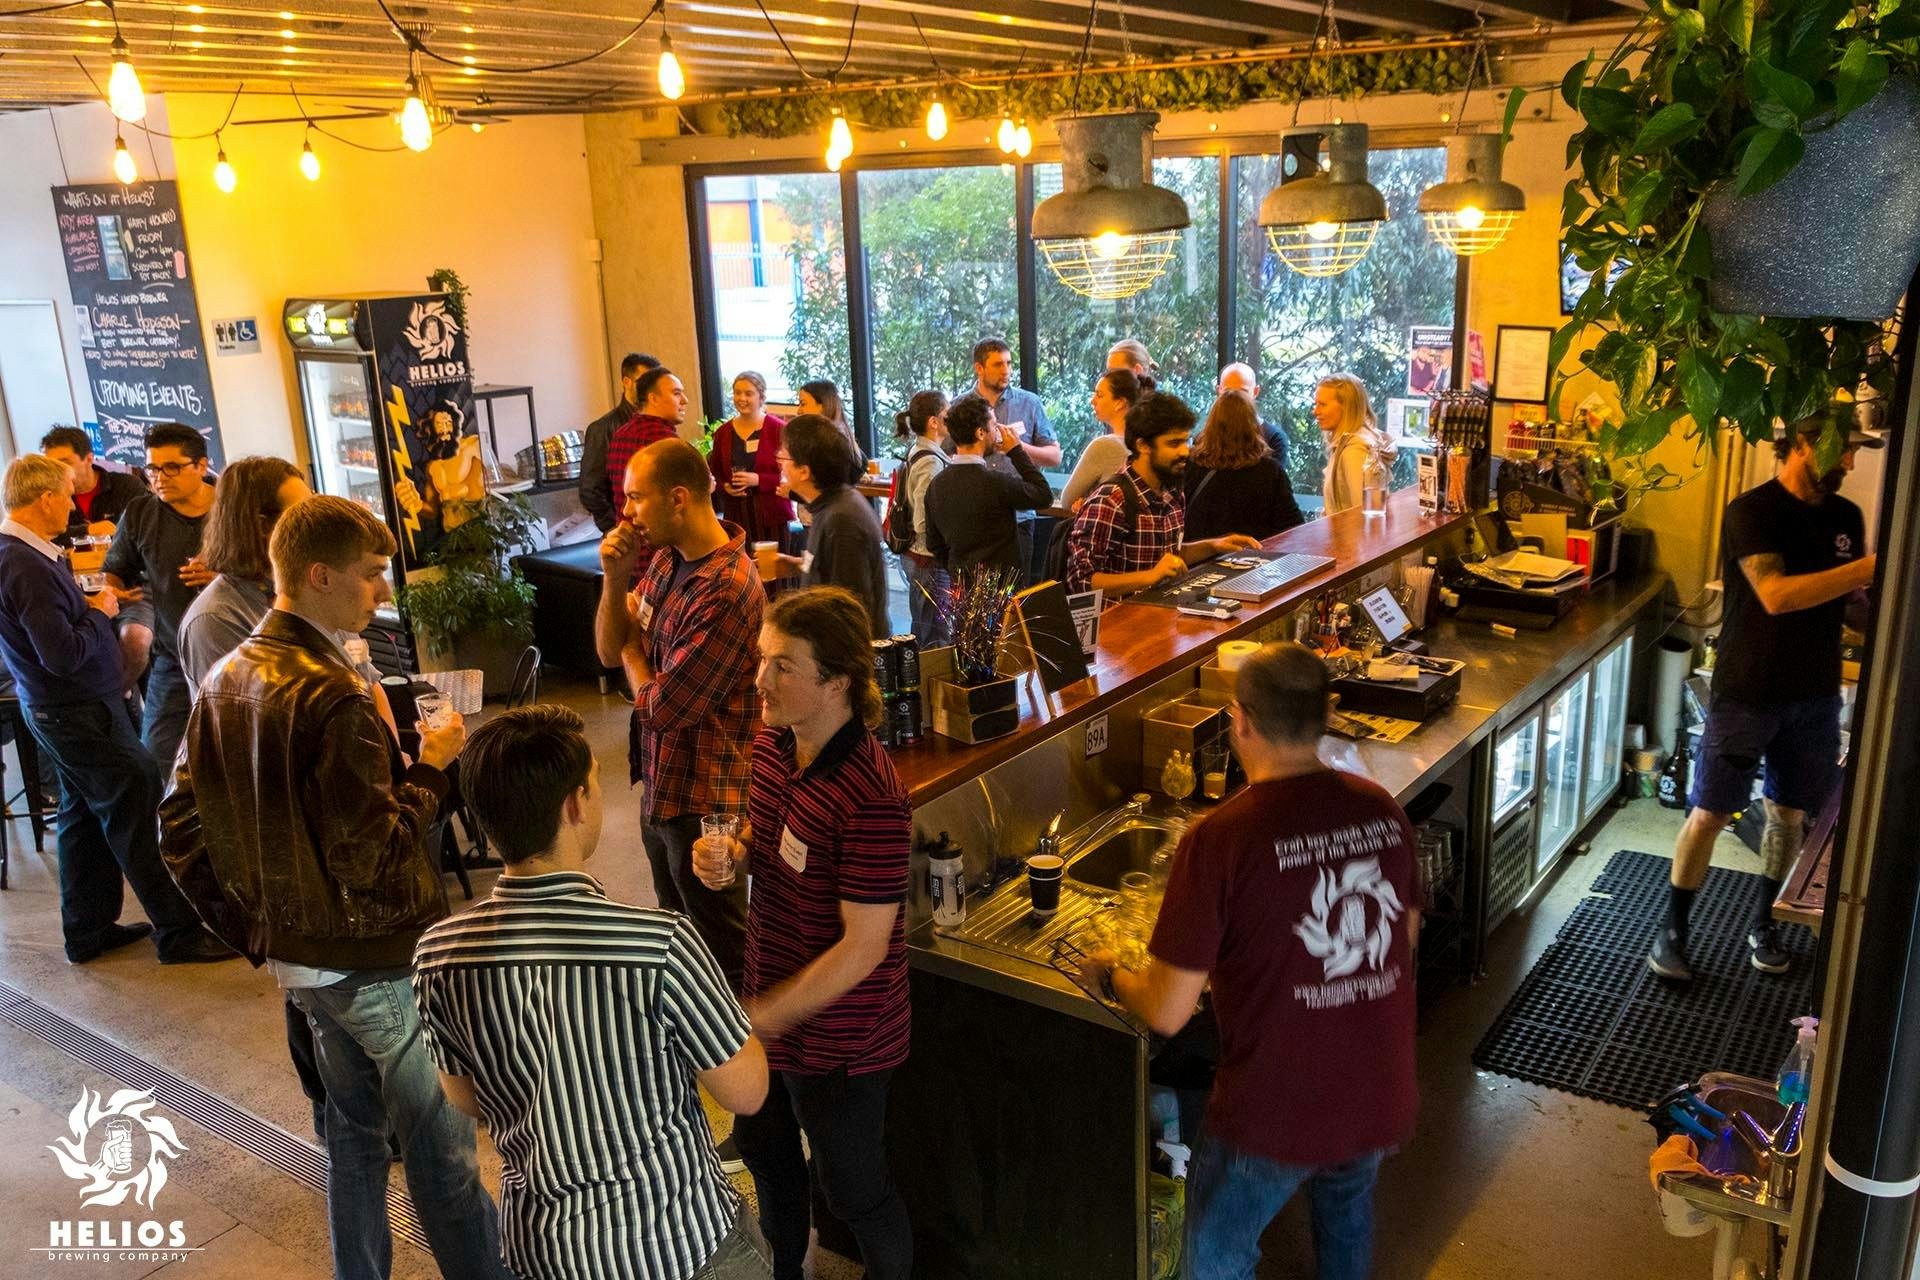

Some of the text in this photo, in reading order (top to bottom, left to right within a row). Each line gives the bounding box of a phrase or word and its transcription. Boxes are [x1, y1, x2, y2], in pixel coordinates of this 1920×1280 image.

[93, 194, 107, 206] ON
[110, 194, 120, 205] AT
[92, 307, 132, 328] CHARLIE
[409, 361, 465, 380] HELIOS
[94, 379, 150, 416] UPCOMING
[1088, 726, 1105, 751] 89A
